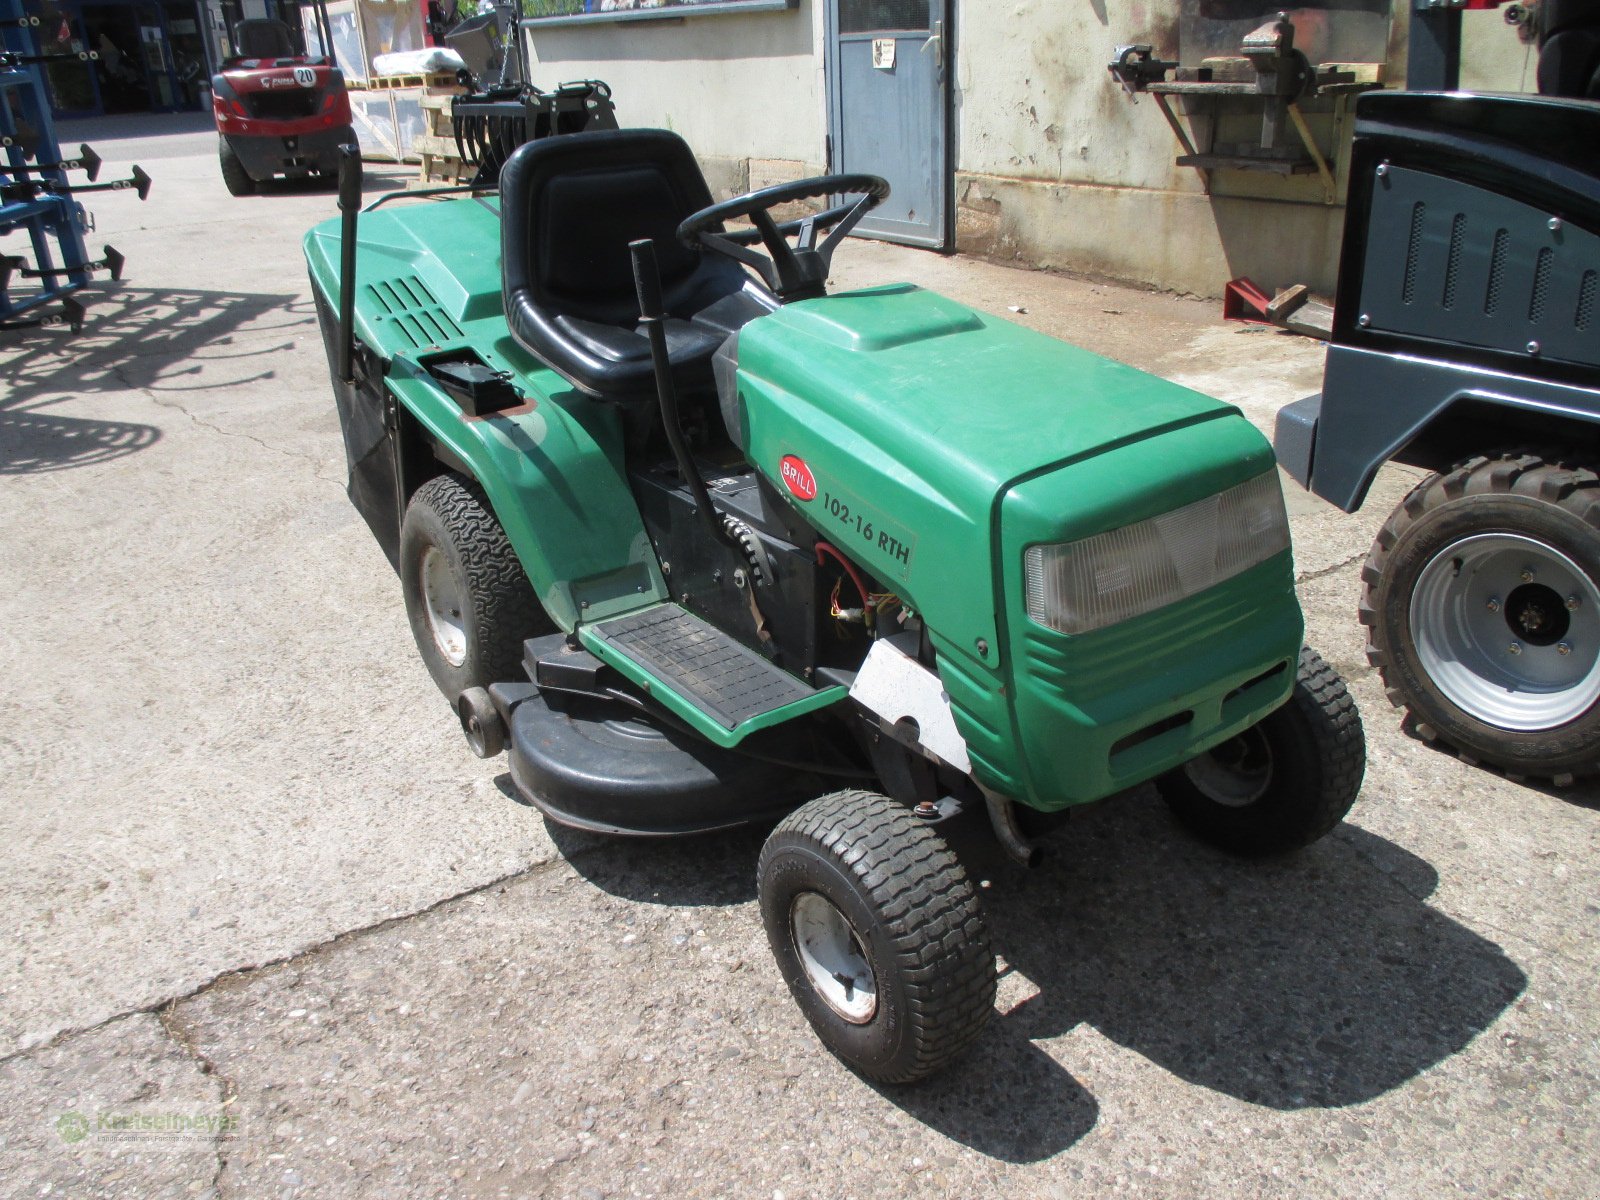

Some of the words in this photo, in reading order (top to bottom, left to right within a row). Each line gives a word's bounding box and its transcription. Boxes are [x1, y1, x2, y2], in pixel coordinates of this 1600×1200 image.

[298, 69, 313, 83] 20
[783, 461, 812, 495] BRILL
[824, 492, 873, 540] 102-16
[877, 530, 910, 565] RTH
